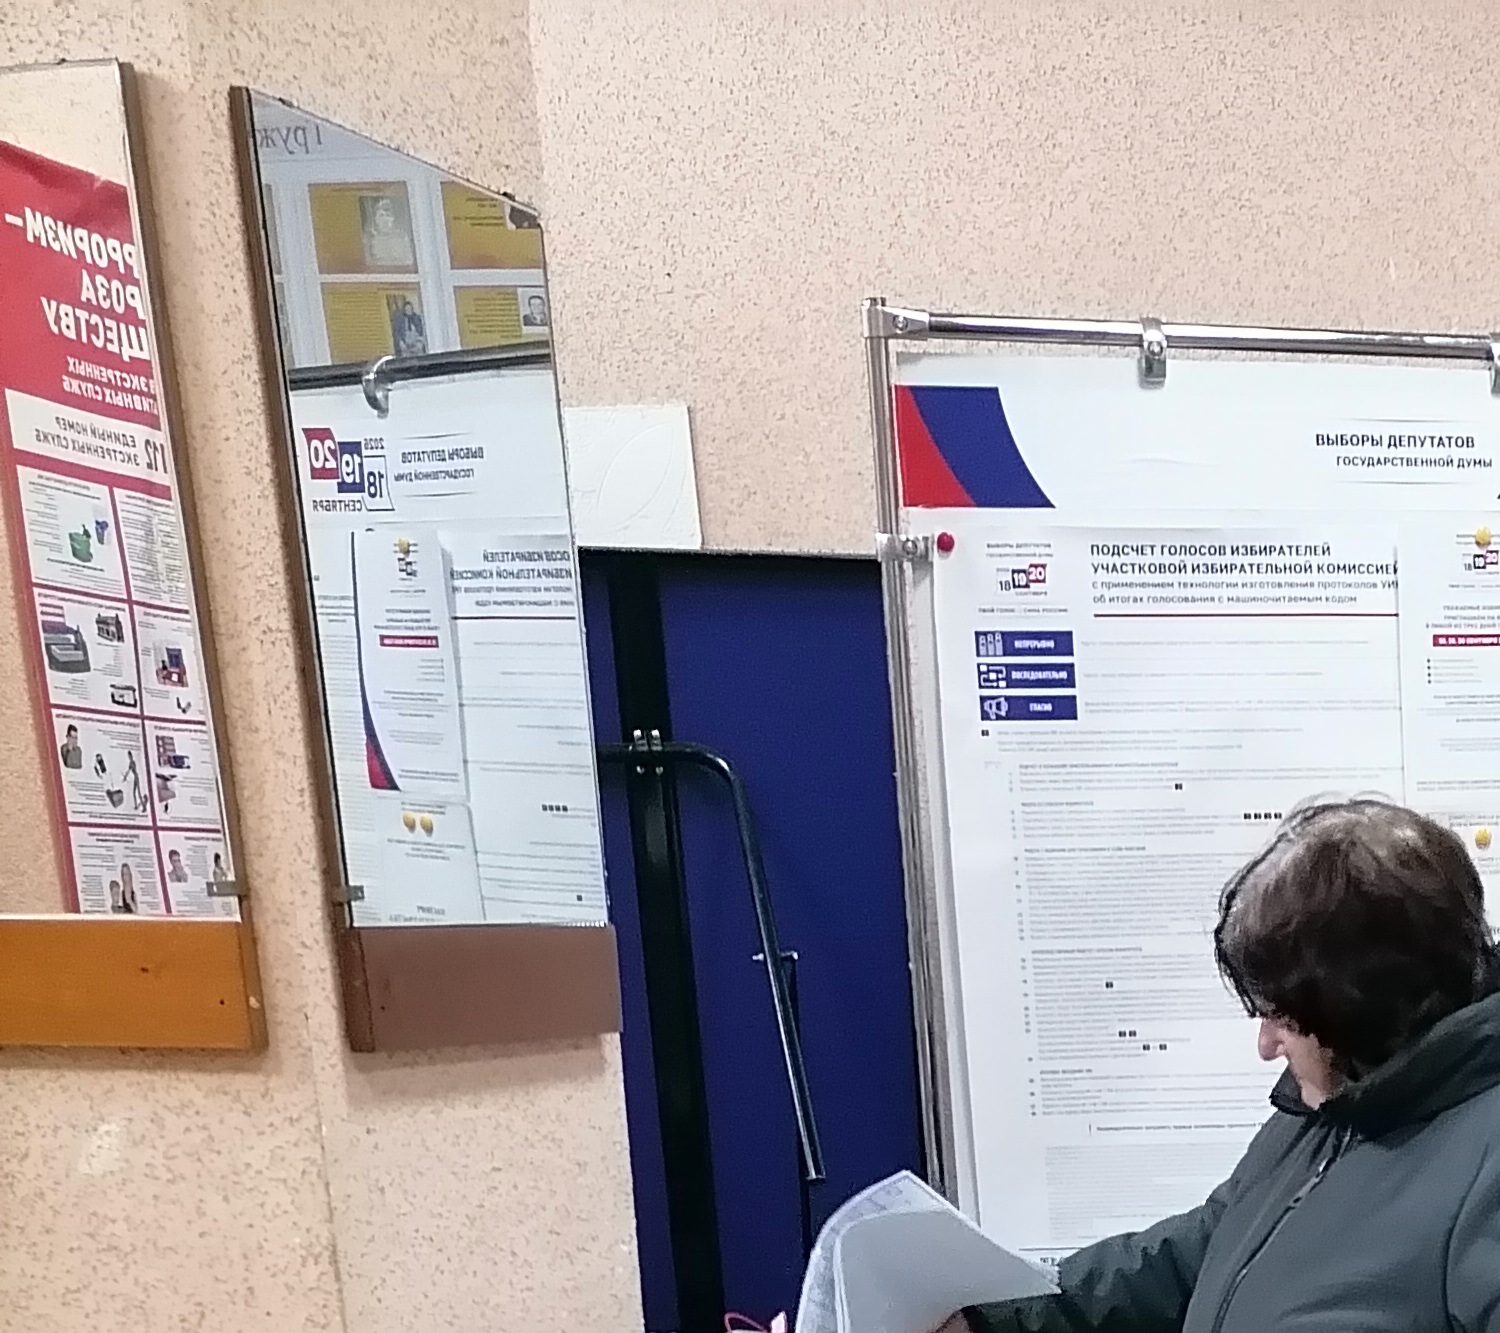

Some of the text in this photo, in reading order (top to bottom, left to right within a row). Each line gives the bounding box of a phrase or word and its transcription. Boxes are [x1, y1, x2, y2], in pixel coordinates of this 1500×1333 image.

[1316, 433, 1475, 449] ВЫБОРЫ ДЕПУТАТОВ
[1336, 455, 1493, 469] ГОСУДАРСТВЕННОЙ ДУМЫ
[1091, 542, 1331, 558] ПОДСЧЕТ ГОЛОСОВ ИЗБИРАТЕЛЕЙ
[1028, 567, 1045, 580] 20
[1091, 560, 1188, 575] УЧАСТКОВОЙ
[1191, 560, 1313, 575] ИЗБИРАТЕЛЬНОЙ
[1101, 580, 1174, 590] применением
[1177, 580, 1239, 590] технологии
[1241, 580, 1315, 589] изготовления
[1317, 580, 1378, 591] протоколов
[1093, 593, 1106, 604] об
[1108, 595, 1144, 603] итогах
[1147, 595, 1216, 604] голосования
[1227, 595, 1323, 604] машиночитаемым
[1325, 595, 1358, 605] кодом
